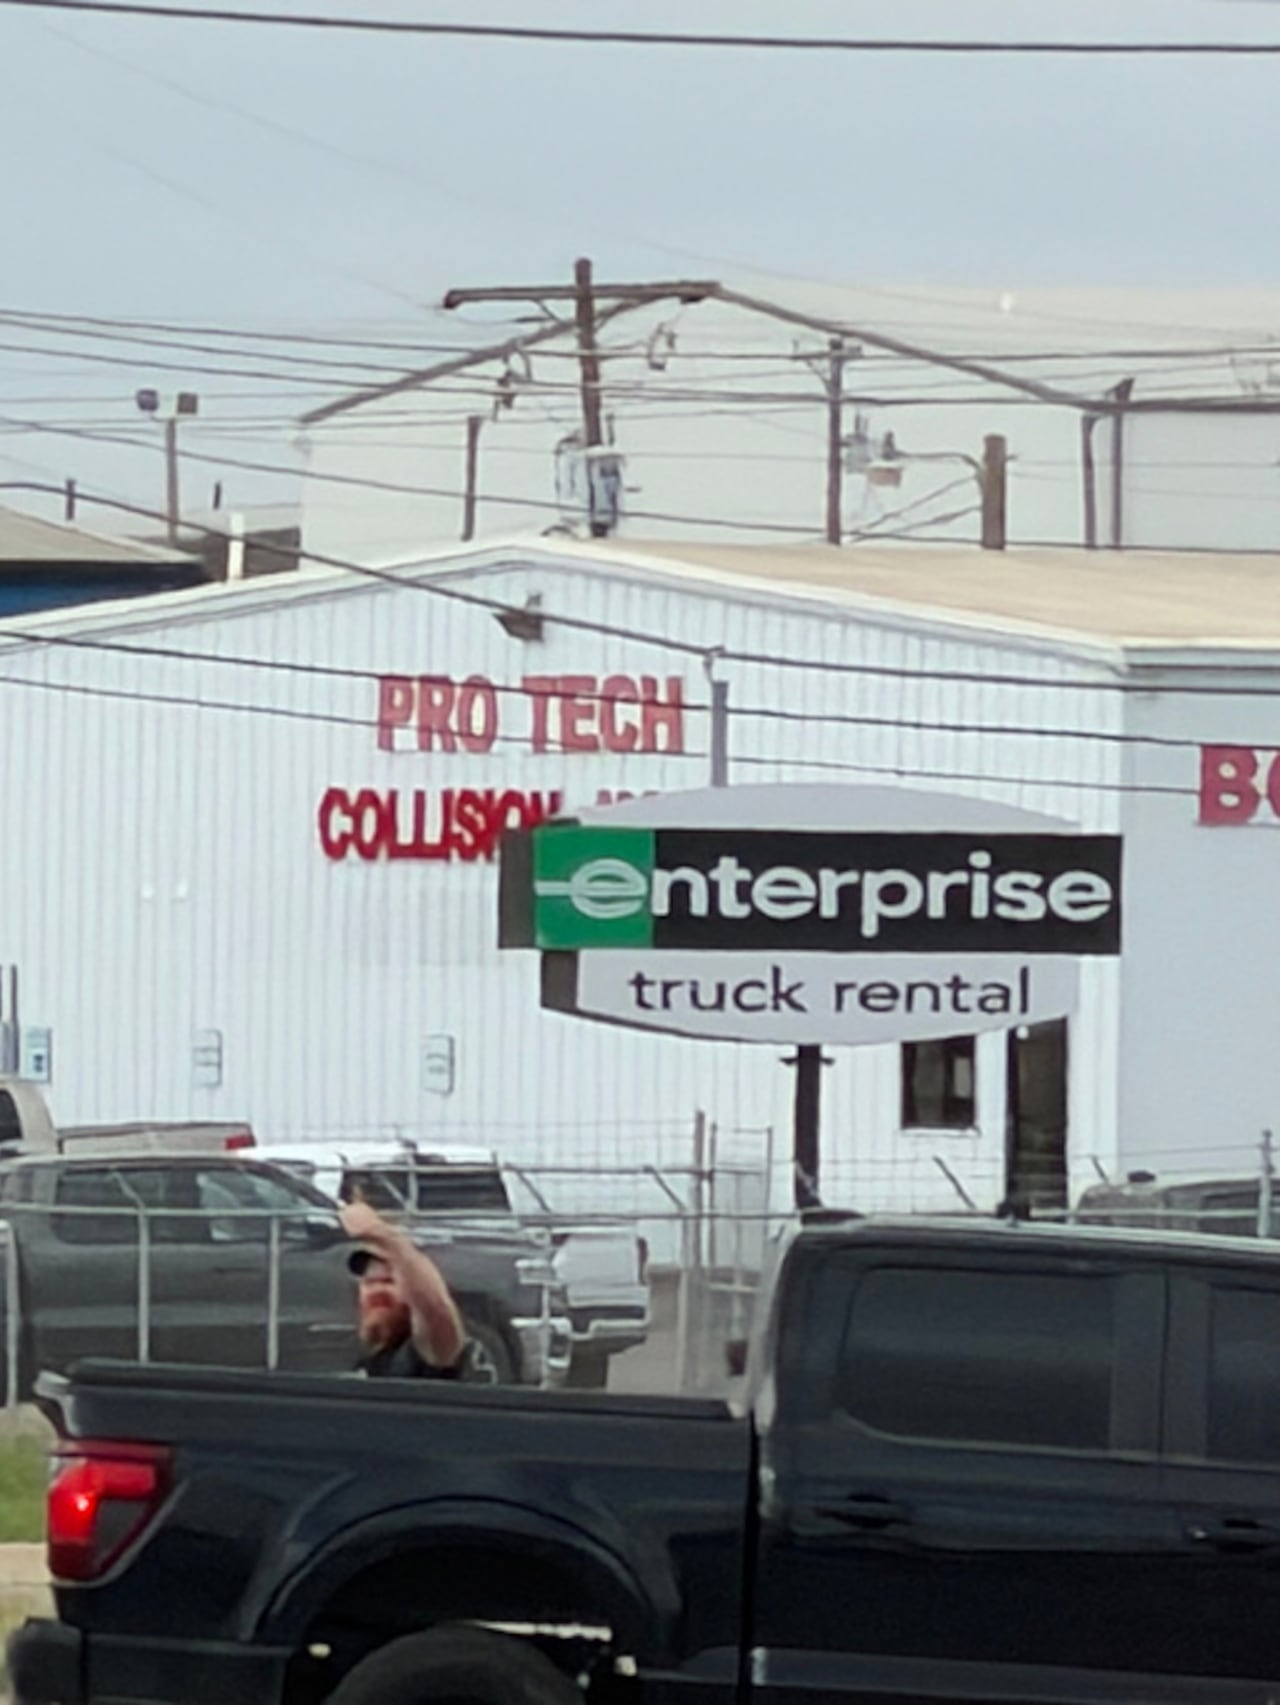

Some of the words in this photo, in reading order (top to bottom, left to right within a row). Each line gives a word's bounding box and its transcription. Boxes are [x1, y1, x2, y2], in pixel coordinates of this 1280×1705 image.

[377, 675, 498, 753] PRO
[522, 675, 684, 754] TECH
[1199, 744, 1280, 826] B
[568, 851, 1113, 938] enterprise
[628, 965, 808, 1013] truck
[833, 966, 1031, 1014] rental
